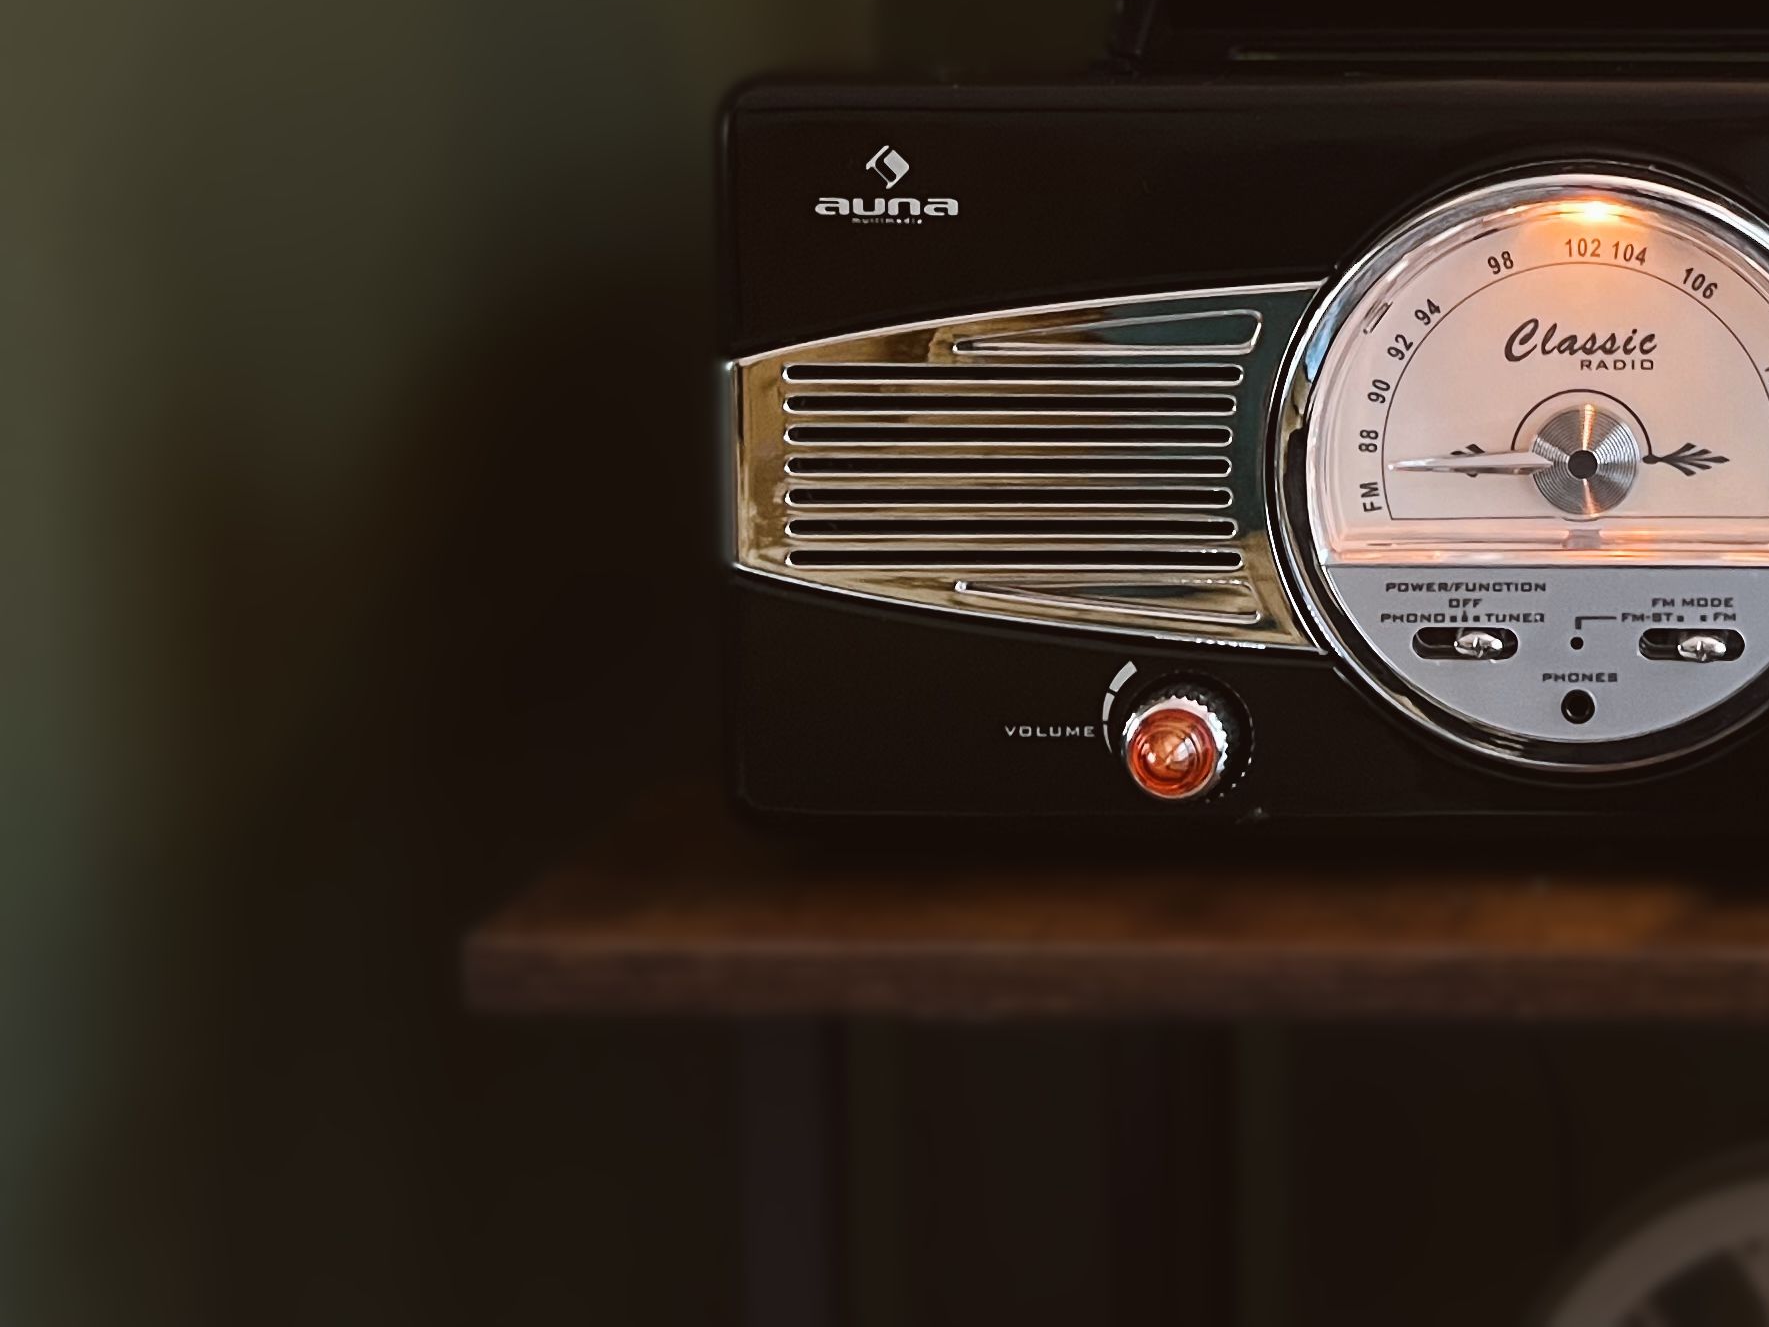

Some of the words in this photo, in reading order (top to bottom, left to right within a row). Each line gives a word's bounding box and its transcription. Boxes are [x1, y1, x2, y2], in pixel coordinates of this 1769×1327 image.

[815, 197, 958, 216] auna
[1564, 238, 1601, 258] 102
[1611, 241, 1647, 265] 104
[1487, 251, 1514, 274] 98
[1683, 267, 1718, 300] 106
[1414, 299, 1441, 326] 94
[1387, 334, 1412, 361] 92
[1504, 318, 1657, 362] Classic
[1580, 359, 1654, 370] RADIO
[1368, 378, 1391, 404] 90
[1358, 429, 1379, 452] 88
[1359, 481, 1383, 513] FM
[1385, 582, 1546, 592] POWER/FUNCTION
[1448, 598, 1482, 608] OFF
[1651, 598, 1675, 608] FM
[1682, 598, 1734, 608] MODE
[1381, 613, 1445, 623] PHONO
[1485, 612, 1545, 623] TUNER
[1621, 612, 1673, 623] FM-ST
[1713, 612, 1736, 622] FM
[1542, 673, 1618, 683] PHONES
[1005, 726, 1095, 737] VOLUME
